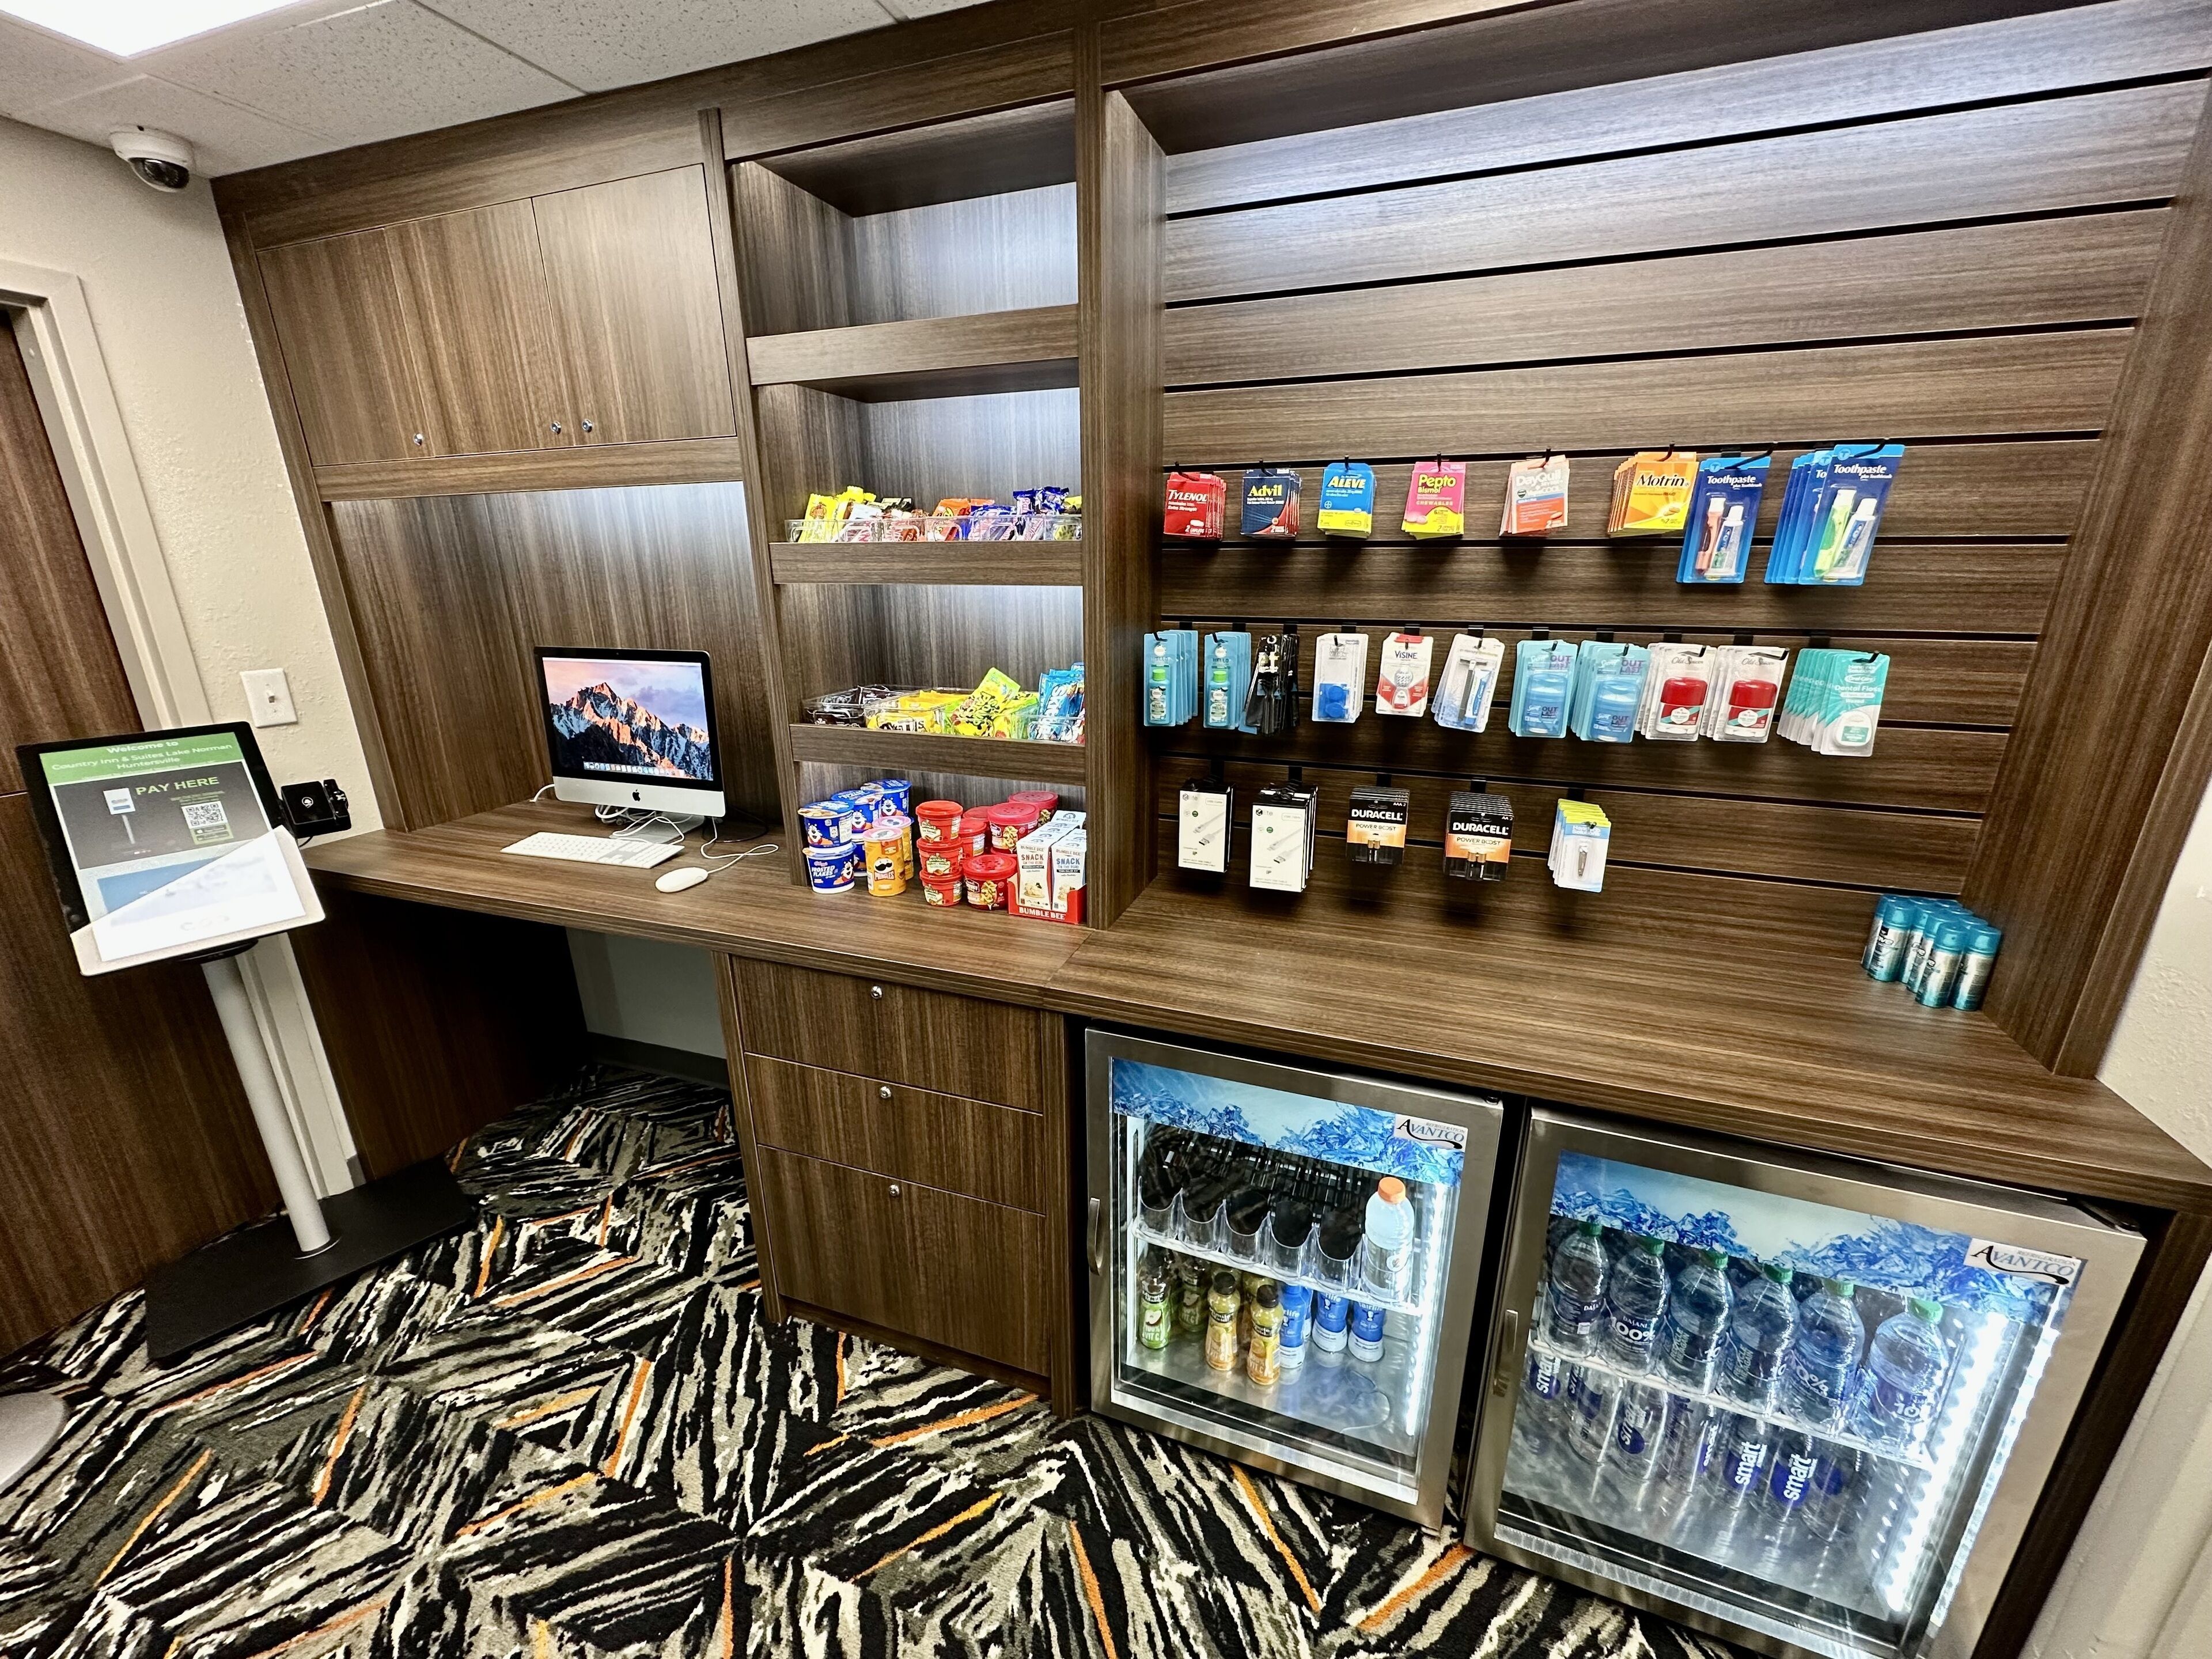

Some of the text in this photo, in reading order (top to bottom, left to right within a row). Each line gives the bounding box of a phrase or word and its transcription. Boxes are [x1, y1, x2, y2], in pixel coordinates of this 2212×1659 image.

[1834, 464, 1887, 476] Toothpaste
[1327, 476, 1366, 489] ALEVE
[1418, 474, 1456, 488] Pepto
[1516, 469, 1562, 487] DayQuil
[1637, 475, 1684, 486] Motrin
[1707, 475, 1756, 486] Toothpaste
[1168, 489, 1208, 502] TYLENOL
[1248, 484, 1282, 497] Advil
[1395, 650, 1418, 659] VISINE
[106, 743, 164, 754] Welcome
[52, 759, 99, 771] Country
[131, 752, 164, 761] Suites
[166, 748, 190, 756] Lake
[192, 744, 232, 754] Norman
[117, 756, 180, 770] Huntersville
[136, 777, 220, 796] PAY HERE
[1351, 809, 1402, 821] DURACELL
[1453, 822, 1508, 835] DURACELL
[1018, 907, 1065, 920] BUMBLE BEE
[1396, 1119, 1464, 1143] AVANTCO
[1970, 1245, 2074, 1277] AVANTCO
[1612, 1316, 1656, 1342] 100%
[1536, 1354, 1554, 1394] smar
[1734, 1441, 1761, 1486] smart
[1783, 1453, 1812, 1501] smart
